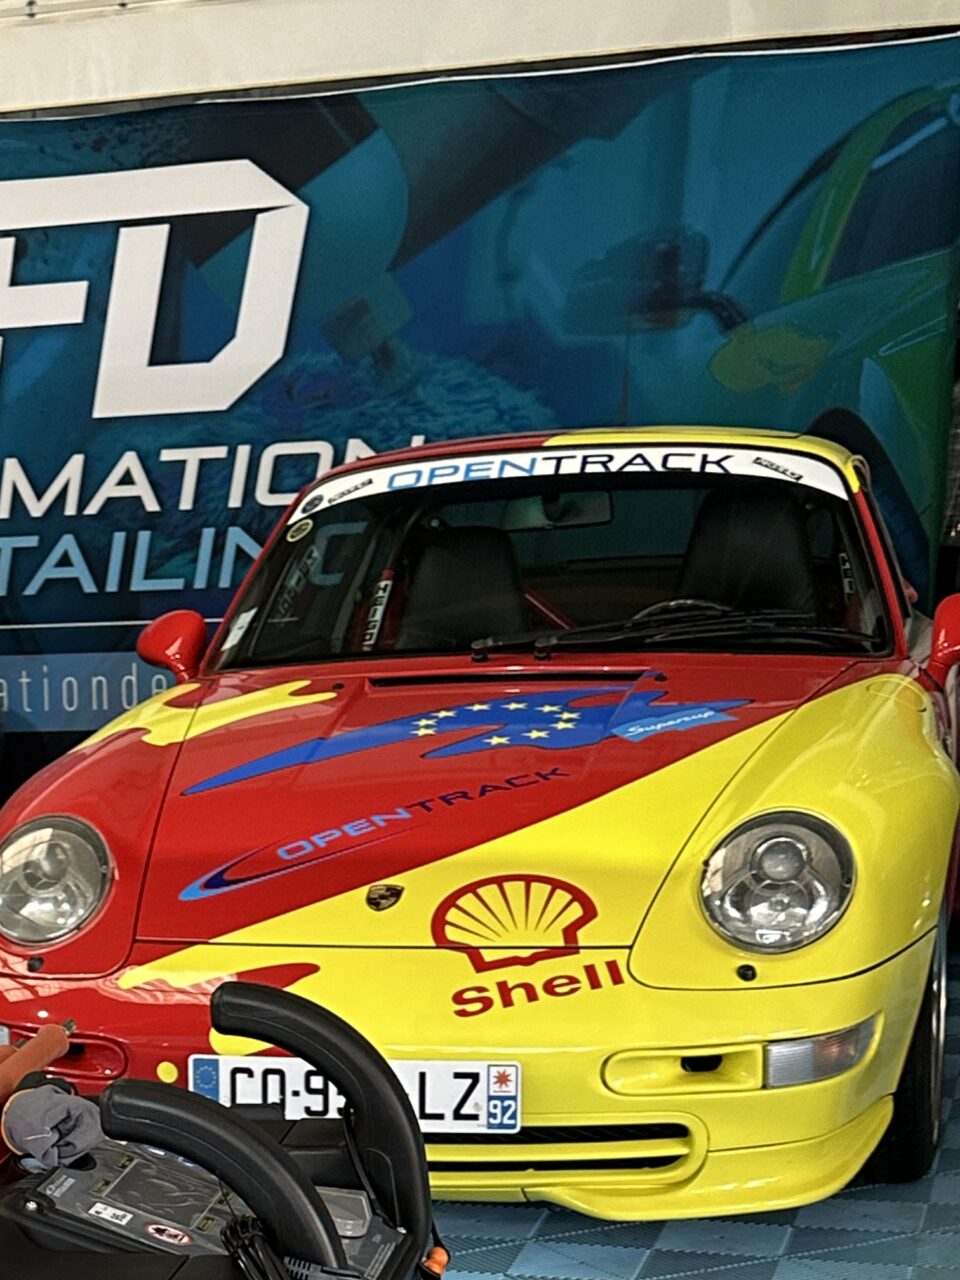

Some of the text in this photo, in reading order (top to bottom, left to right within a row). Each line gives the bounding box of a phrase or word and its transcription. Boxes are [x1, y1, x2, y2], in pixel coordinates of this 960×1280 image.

[387, 452, 735, 492] OPENTRACK
[276, 767, 571, 860] OPENTRACK
[451, 958, 629, 1019] Shell
[488, 1099, 517, 1125] 92
